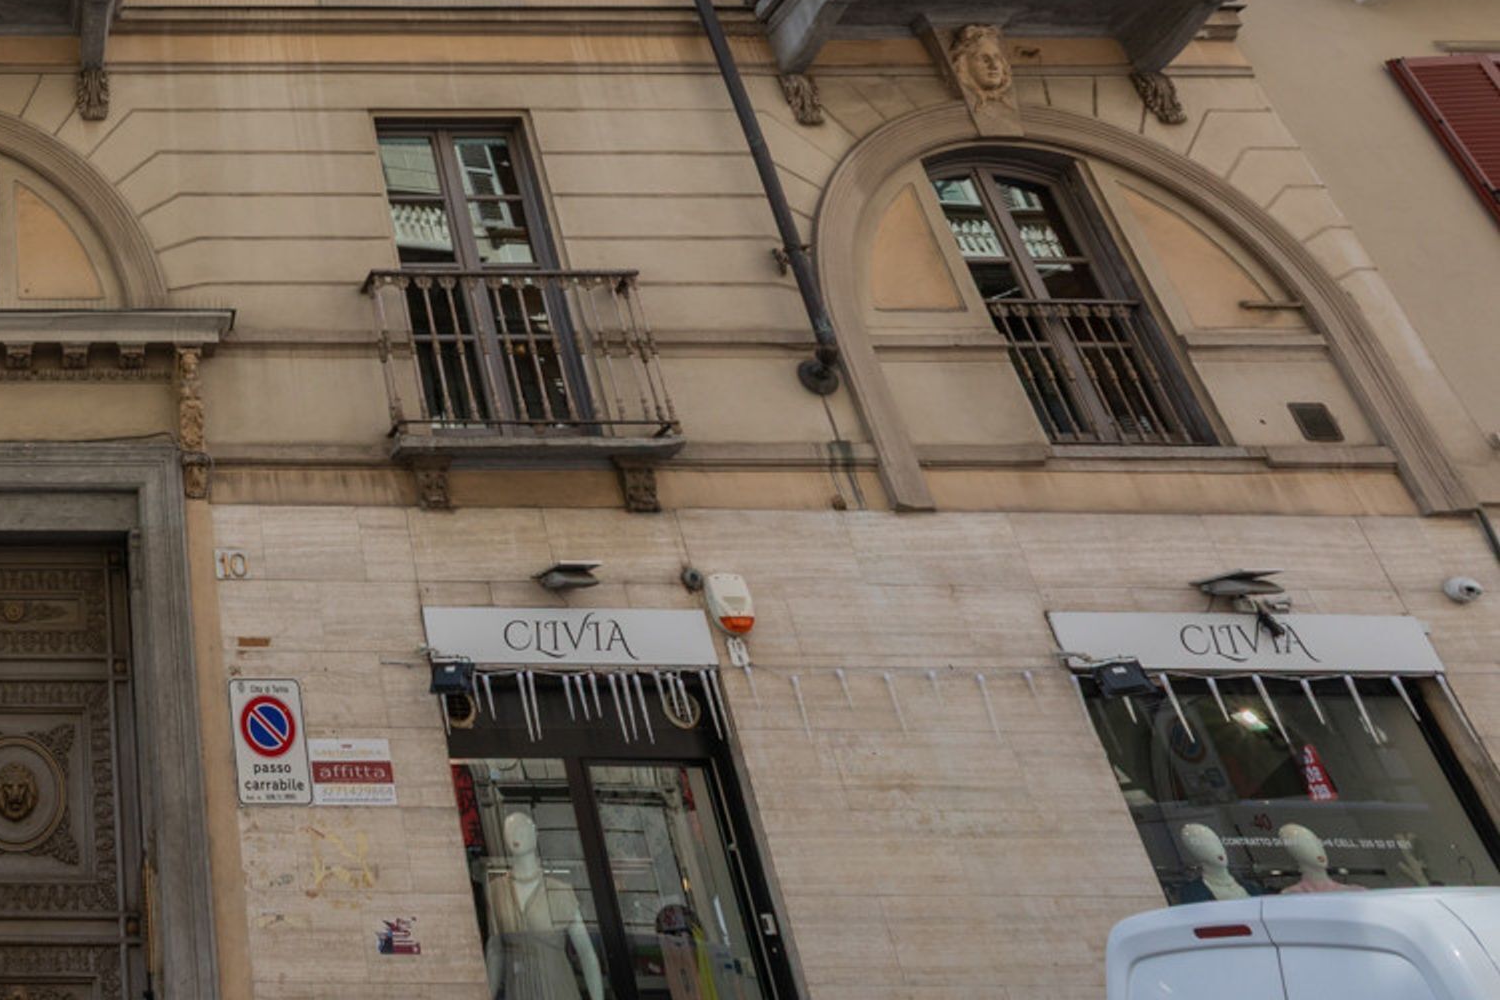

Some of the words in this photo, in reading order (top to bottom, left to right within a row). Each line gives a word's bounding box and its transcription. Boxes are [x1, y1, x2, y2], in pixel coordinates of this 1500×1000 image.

[219, 552, 249, 577] 10
[503, 612, 639, 660] CLIVIA
[253, 763, 292, 775] passo
[319, 764, 386, 779] affitta
[244, 779, 305, 792] carrabile
